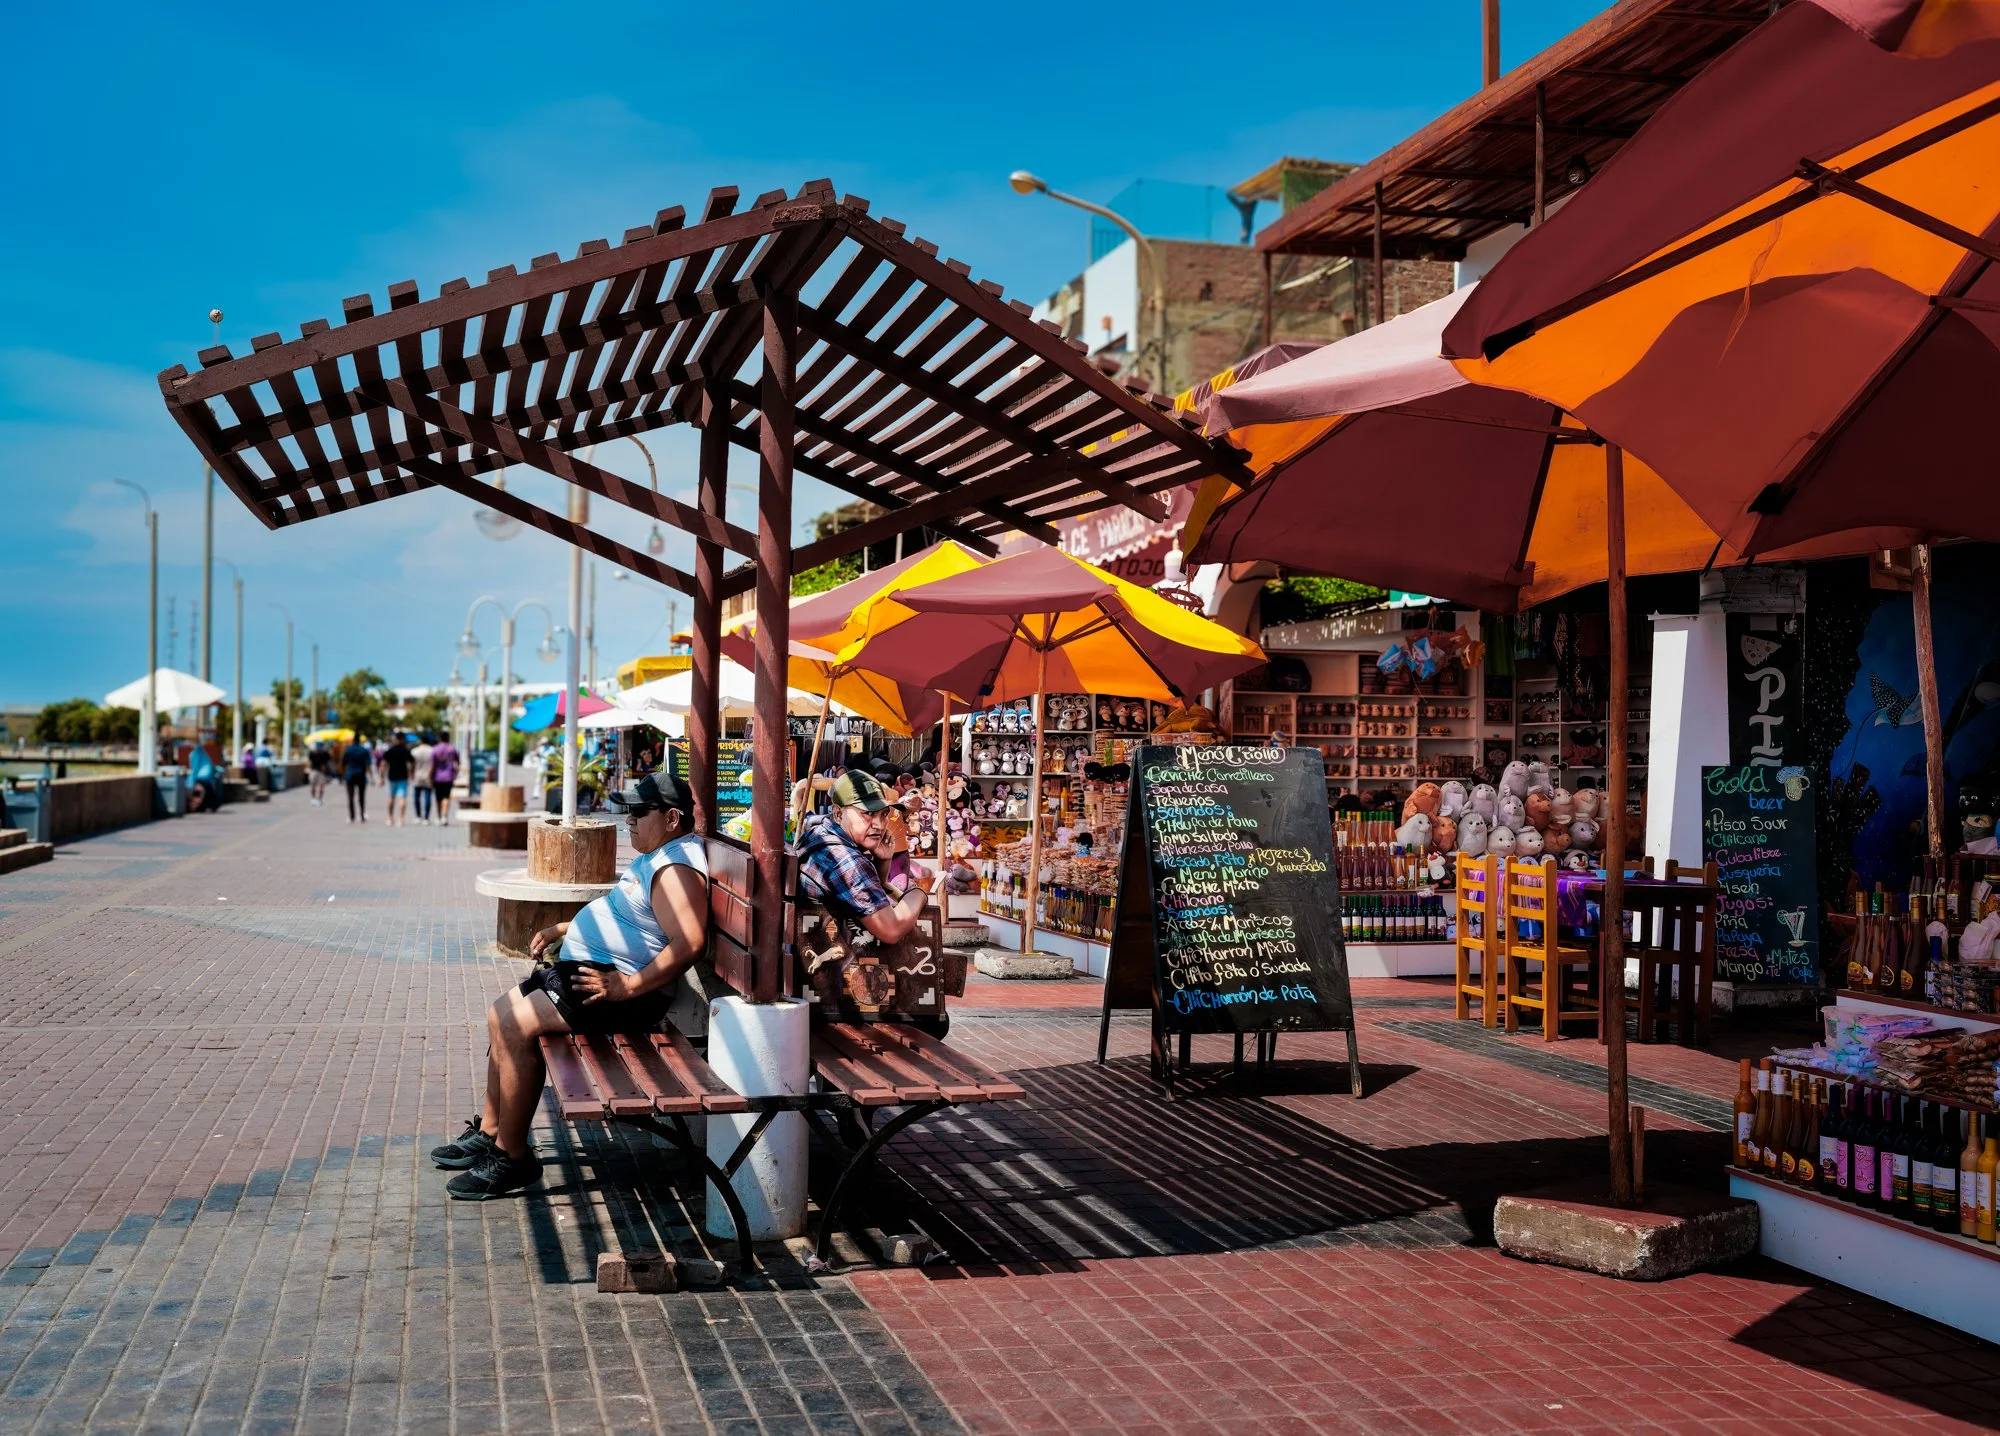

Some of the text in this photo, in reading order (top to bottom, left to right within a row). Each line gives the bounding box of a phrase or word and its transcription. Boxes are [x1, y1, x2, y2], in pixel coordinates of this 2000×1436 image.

[1181, 746, 1279, 770] Menú Criollo
[1207, 767, 1274, 782] Carretillero
[1704, 766, 1770, 795] Cold
[1151, 784, 1182, 797] Sopa
[1182, 782, 1194, 794] de
[1749, 793, 1785, 810] beer
[1209, 817, 1224, 827] de
[1227, 816, 1257, 828] Pollo
[1711, 808, 1788, 832] Pisco Sour
[1228, 841, 1253, 852] Pollo
[1162, 855, 1210, 869] Pescado
[1716, 849, 1753, 866] Cuba
[1180, 863, 1268, 883] Menú Marino
[1717, 864, 1781, 884] Cusqueña
[1164, 916, 1206, 932] Arroz
[1223, 913, 1293, 931] Mariscos
[1715, 913, 1748, 928] Piña
[1217, 932, 1234, 943] de
[1234, 928, 1295, 947] Mariscos
[1716, 944, 1759, 960] Fresa
[1771, 948, 1809, 969] Mates
[1263, 958, 1311, 976] Sudada
[1717, 959, 1763, 981] Mango
[1791, 964, 1813, 983] Café
[1259, 986, 1278, 1001] de
[1281, 984, 1318, 1003] Pota
